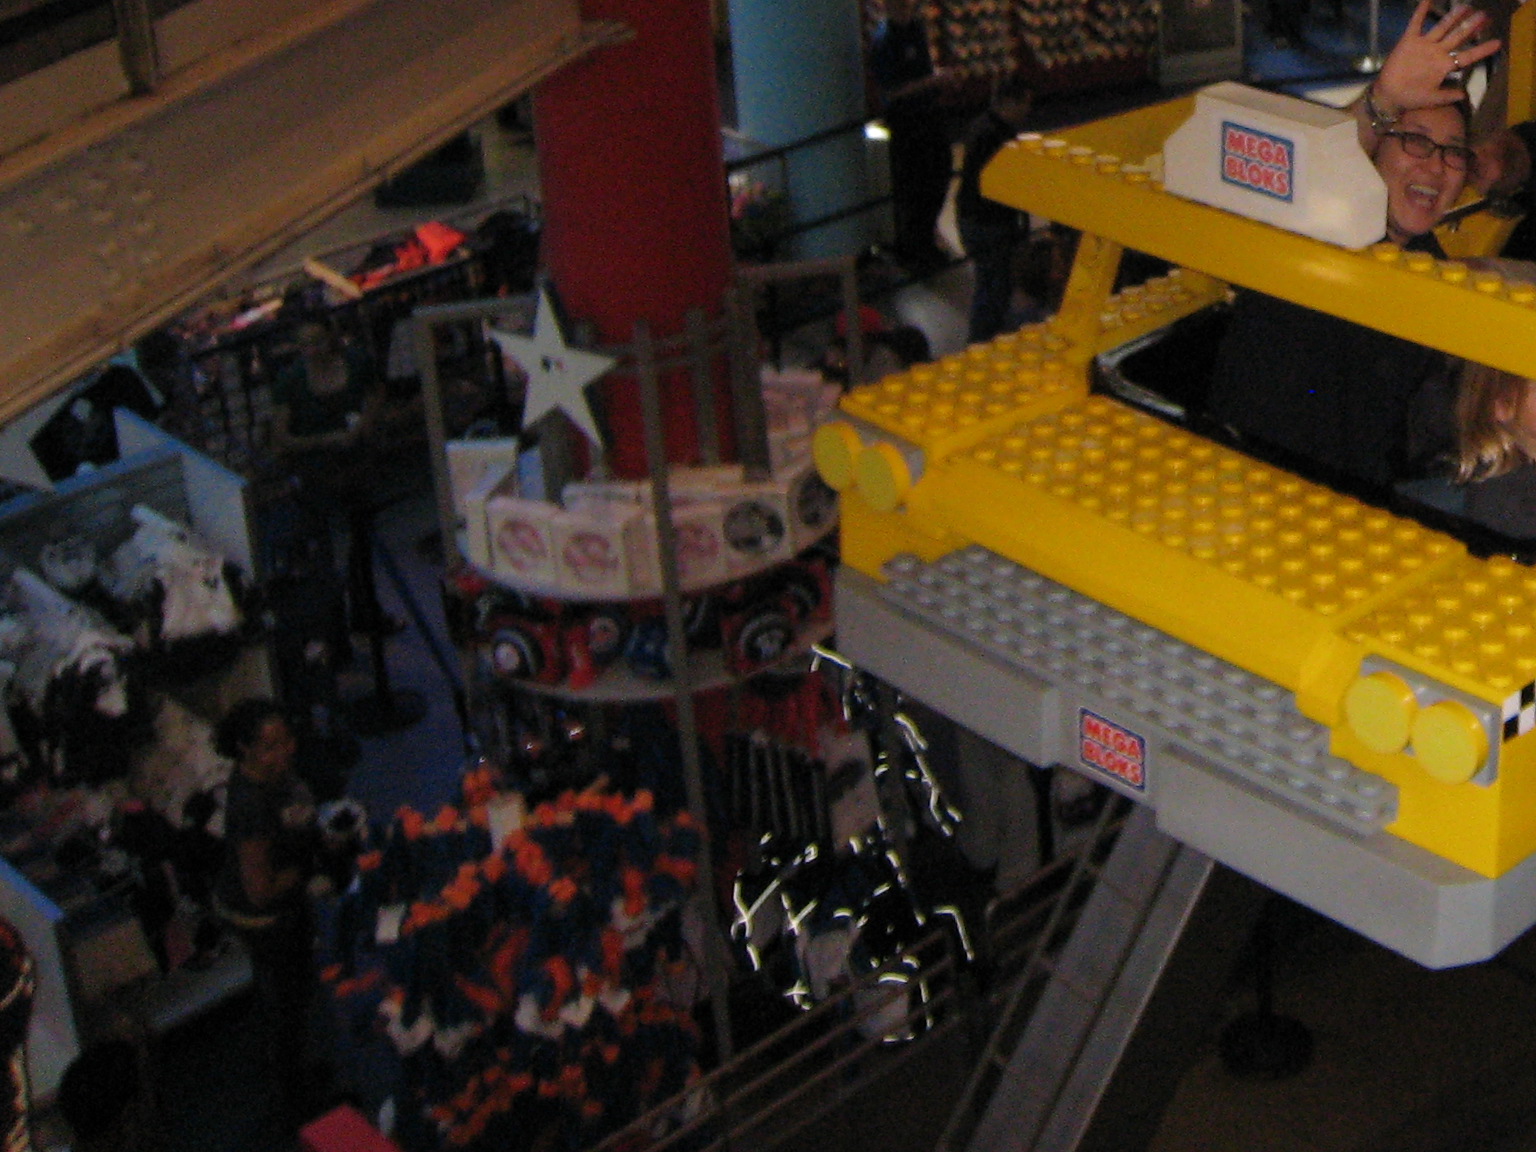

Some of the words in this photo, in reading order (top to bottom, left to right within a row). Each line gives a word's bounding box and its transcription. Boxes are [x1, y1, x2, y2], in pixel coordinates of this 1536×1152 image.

[1226, 129, 1289, 167] MEGA
[1225, 156, 1289, 195] BLOKS
[1084, 716, 1140, 760] MEGA
[1083, 739, 1141, 784] BLOKS
